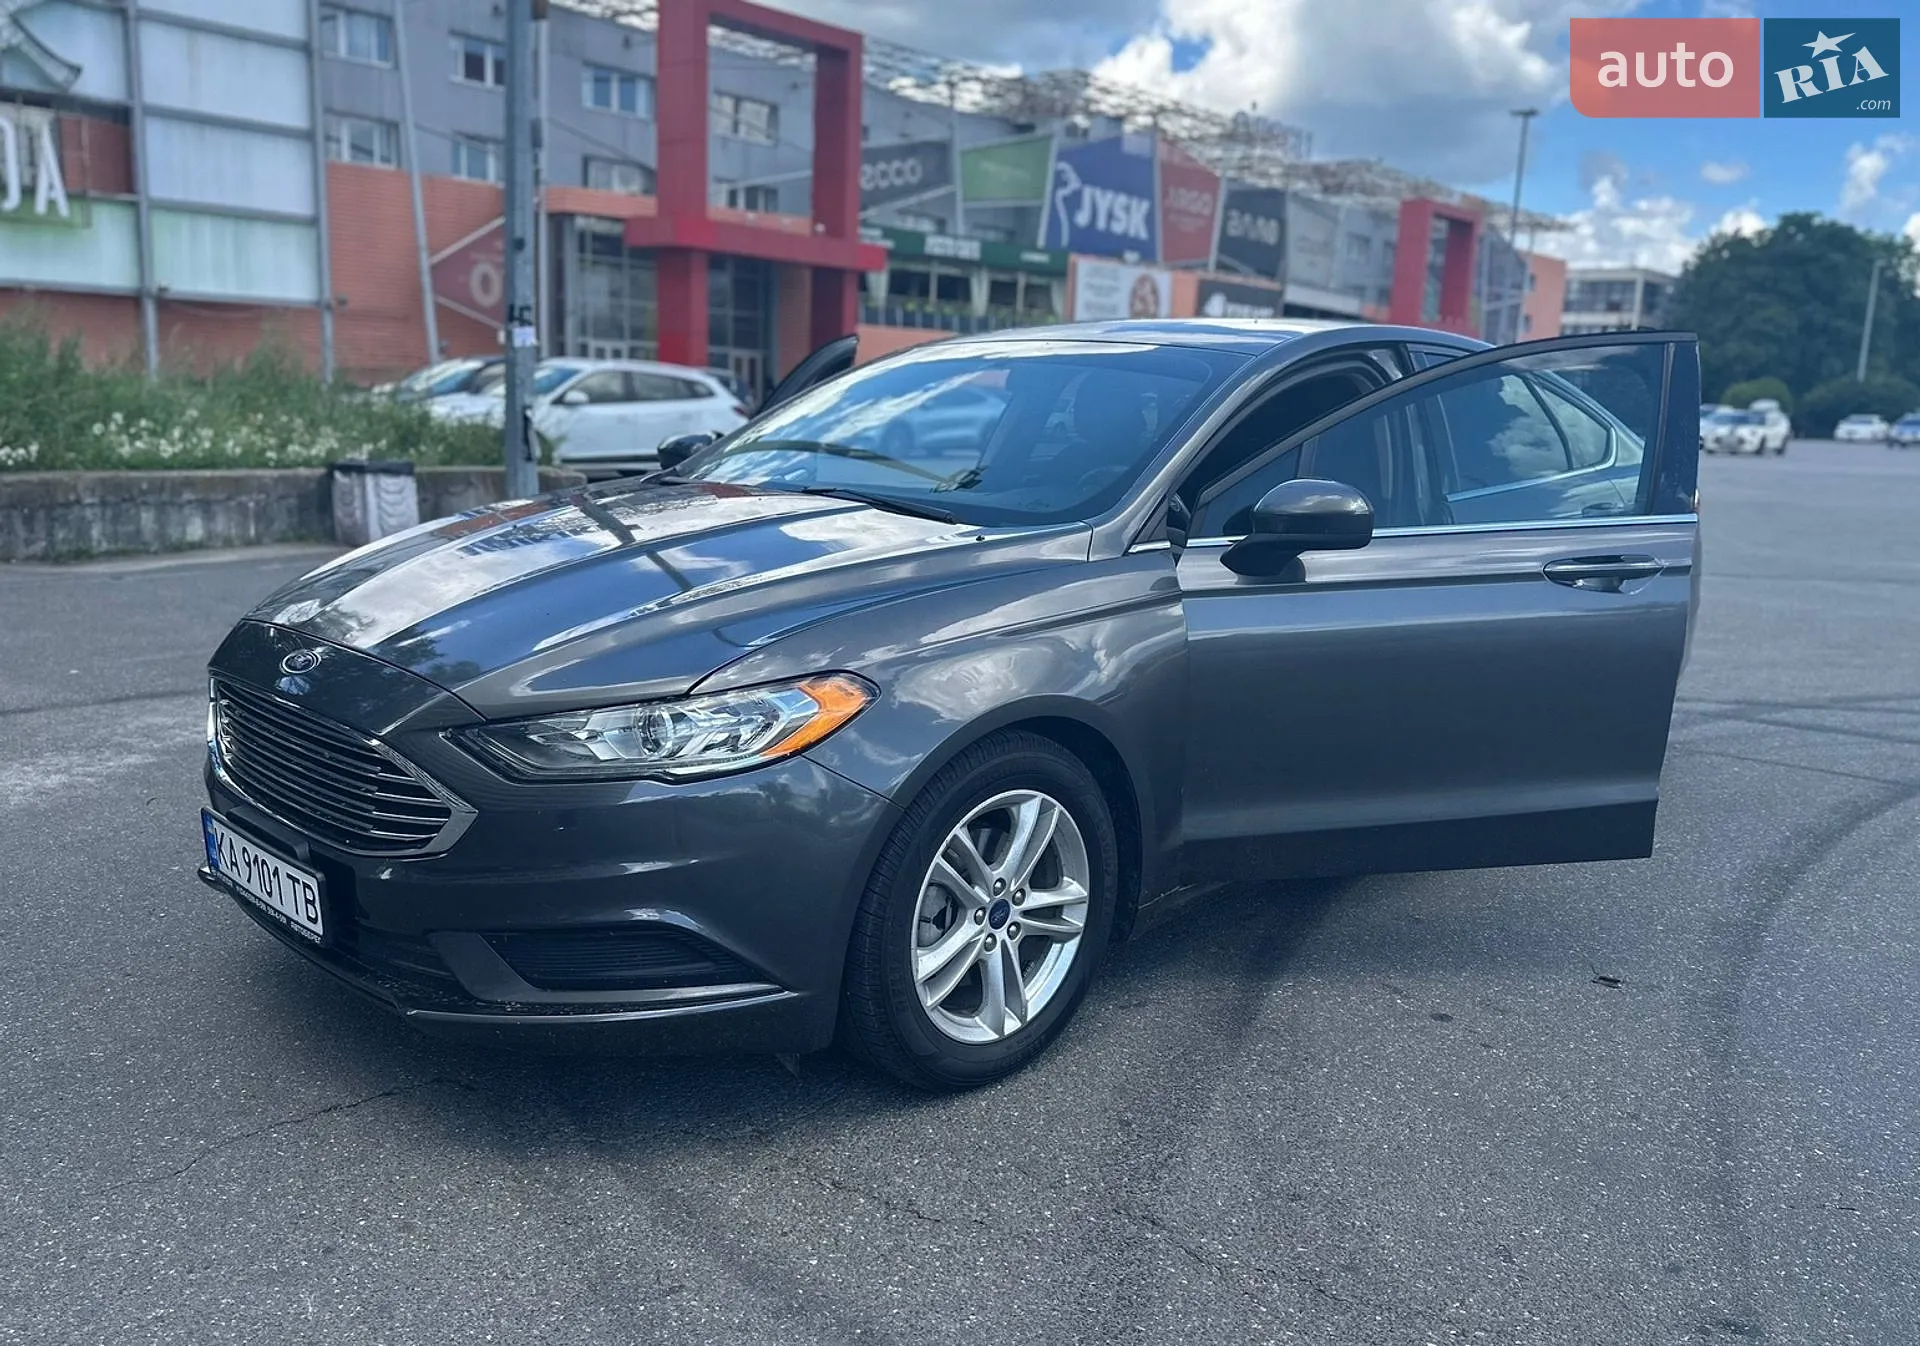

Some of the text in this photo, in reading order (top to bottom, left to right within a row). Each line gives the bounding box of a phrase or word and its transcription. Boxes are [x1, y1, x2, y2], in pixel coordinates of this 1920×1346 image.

[1074, 184, 1151, 241] JYSK
[214, 827, 241, 878] KA
[242, 846, 284, 906] 9101
[286, 872, 319, 925] TB
